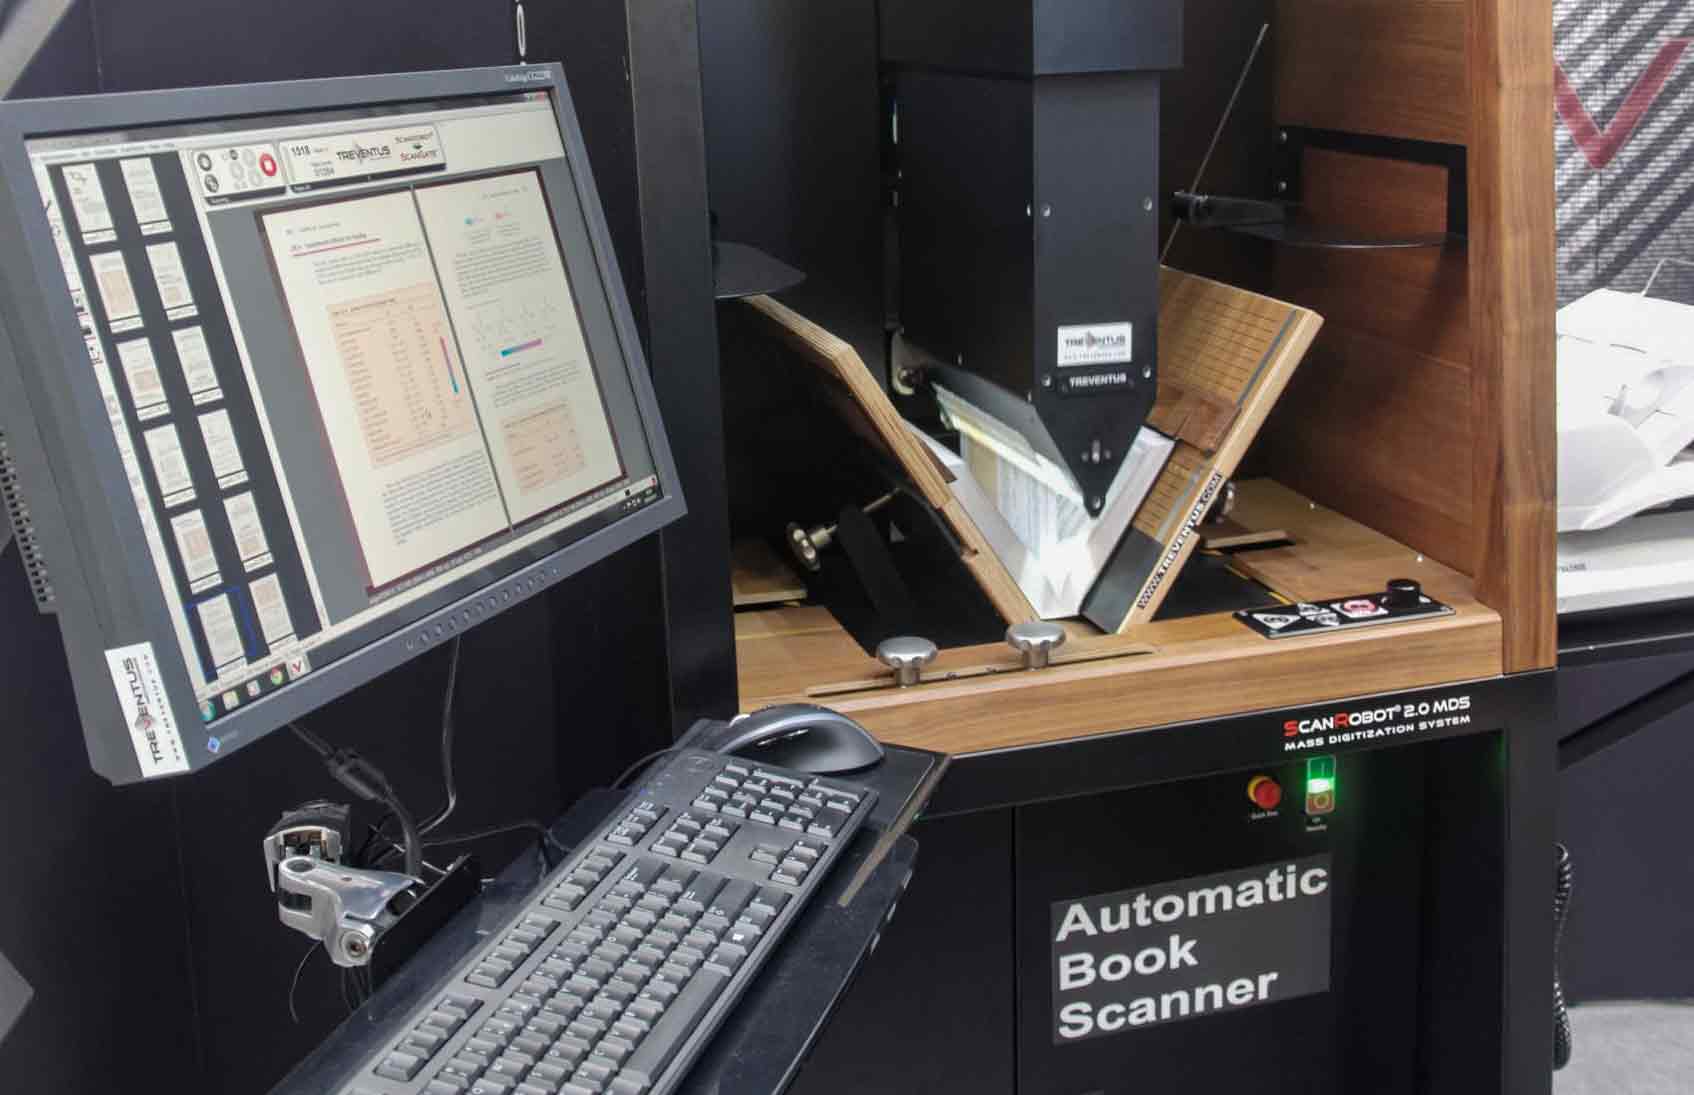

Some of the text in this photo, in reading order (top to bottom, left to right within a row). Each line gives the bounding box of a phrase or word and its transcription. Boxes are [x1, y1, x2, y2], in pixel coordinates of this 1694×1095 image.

[336, 145, 392, 161] TREVENTUS
[1404, 703, 1430, 718] 2.0
[1432, 696, 1471, 713] MDS
[1285, 715, 1471, 751] MASS DIGITIZATION SYSTEM
[1056, 864, 1328, 942] Automatic
[1059, 934, 1199, 991] Book
[1058, 972, 1279, 1038] Scanner
